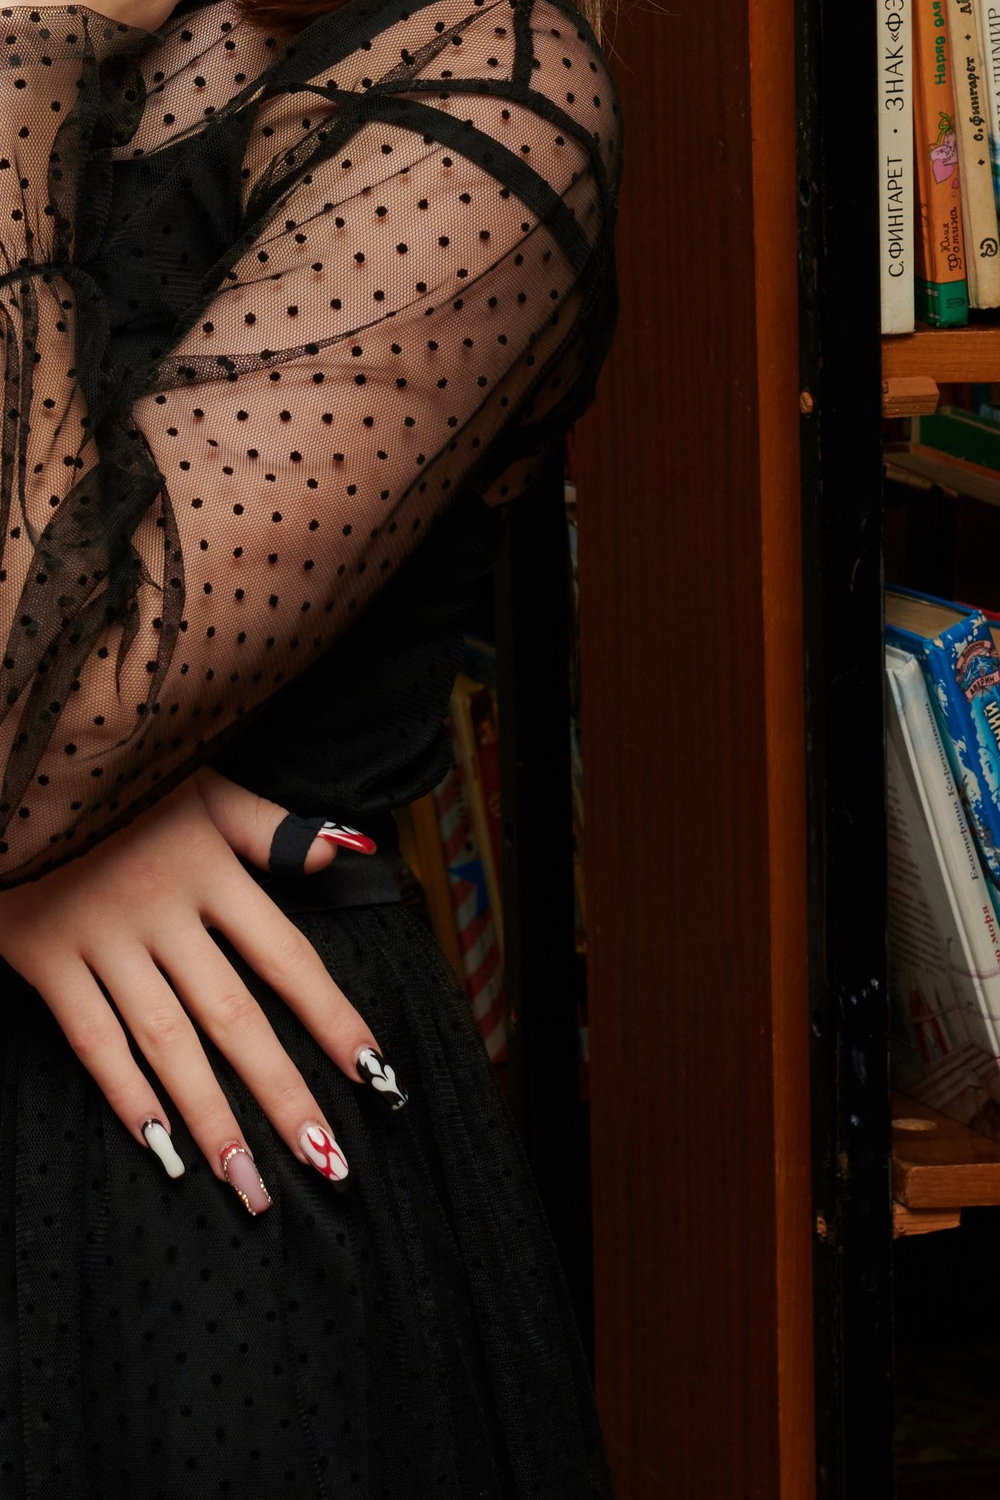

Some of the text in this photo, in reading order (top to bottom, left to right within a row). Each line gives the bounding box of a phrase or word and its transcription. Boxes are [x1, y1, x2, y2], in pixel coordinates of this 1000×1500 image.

[932, 1, 946, 28] для
[884, 45, 904, 112] ЗНАК
[932, 34, 947, 86] Наряд
[969, 675, 995, 696] АВЕРИН
